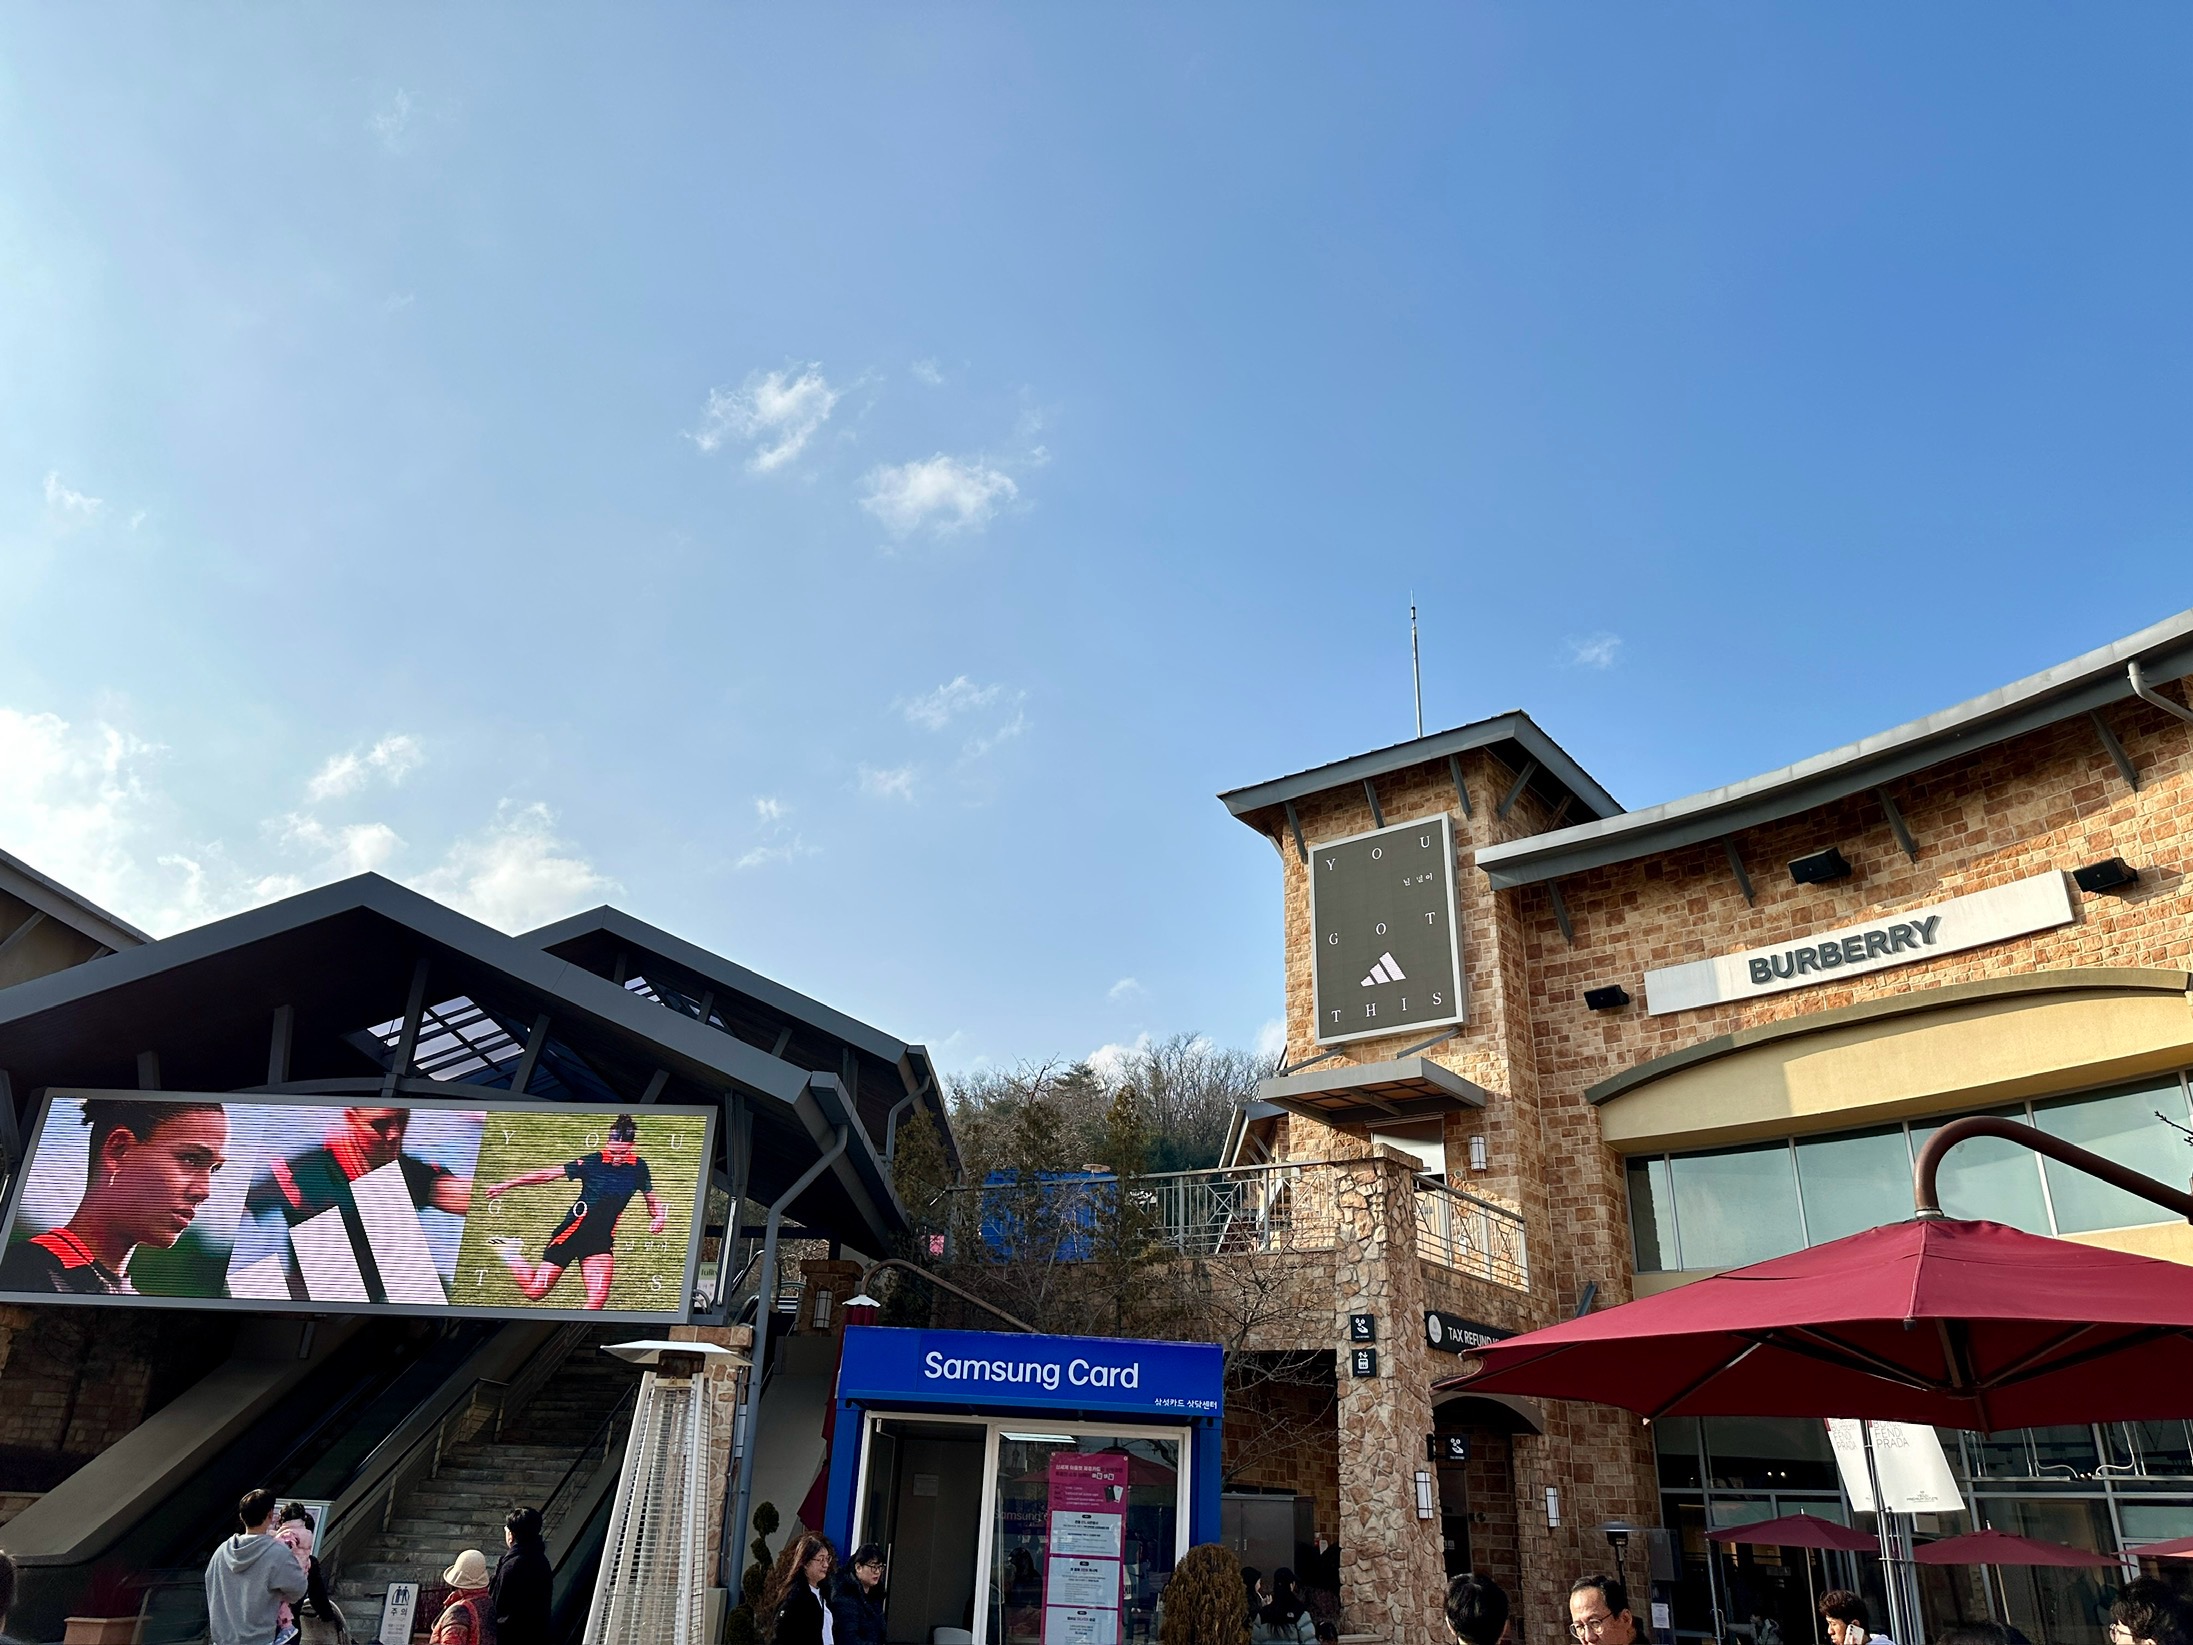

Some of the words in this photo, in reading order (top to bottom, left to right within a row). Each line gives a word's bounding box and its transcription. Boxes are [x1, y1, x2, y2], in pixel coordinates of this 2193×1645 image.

[1747, 915, 1942, 984] BURBERRY
[1447, 1326, 1464, 1343] TAX
[924, 1351, 1060, 1391] Samsung
[1068, 1358, 1139, 1389] Card
[1874, 1427, 1904, 1438] FENDI
[1876, 1437, 1910, 1449] PRADA
